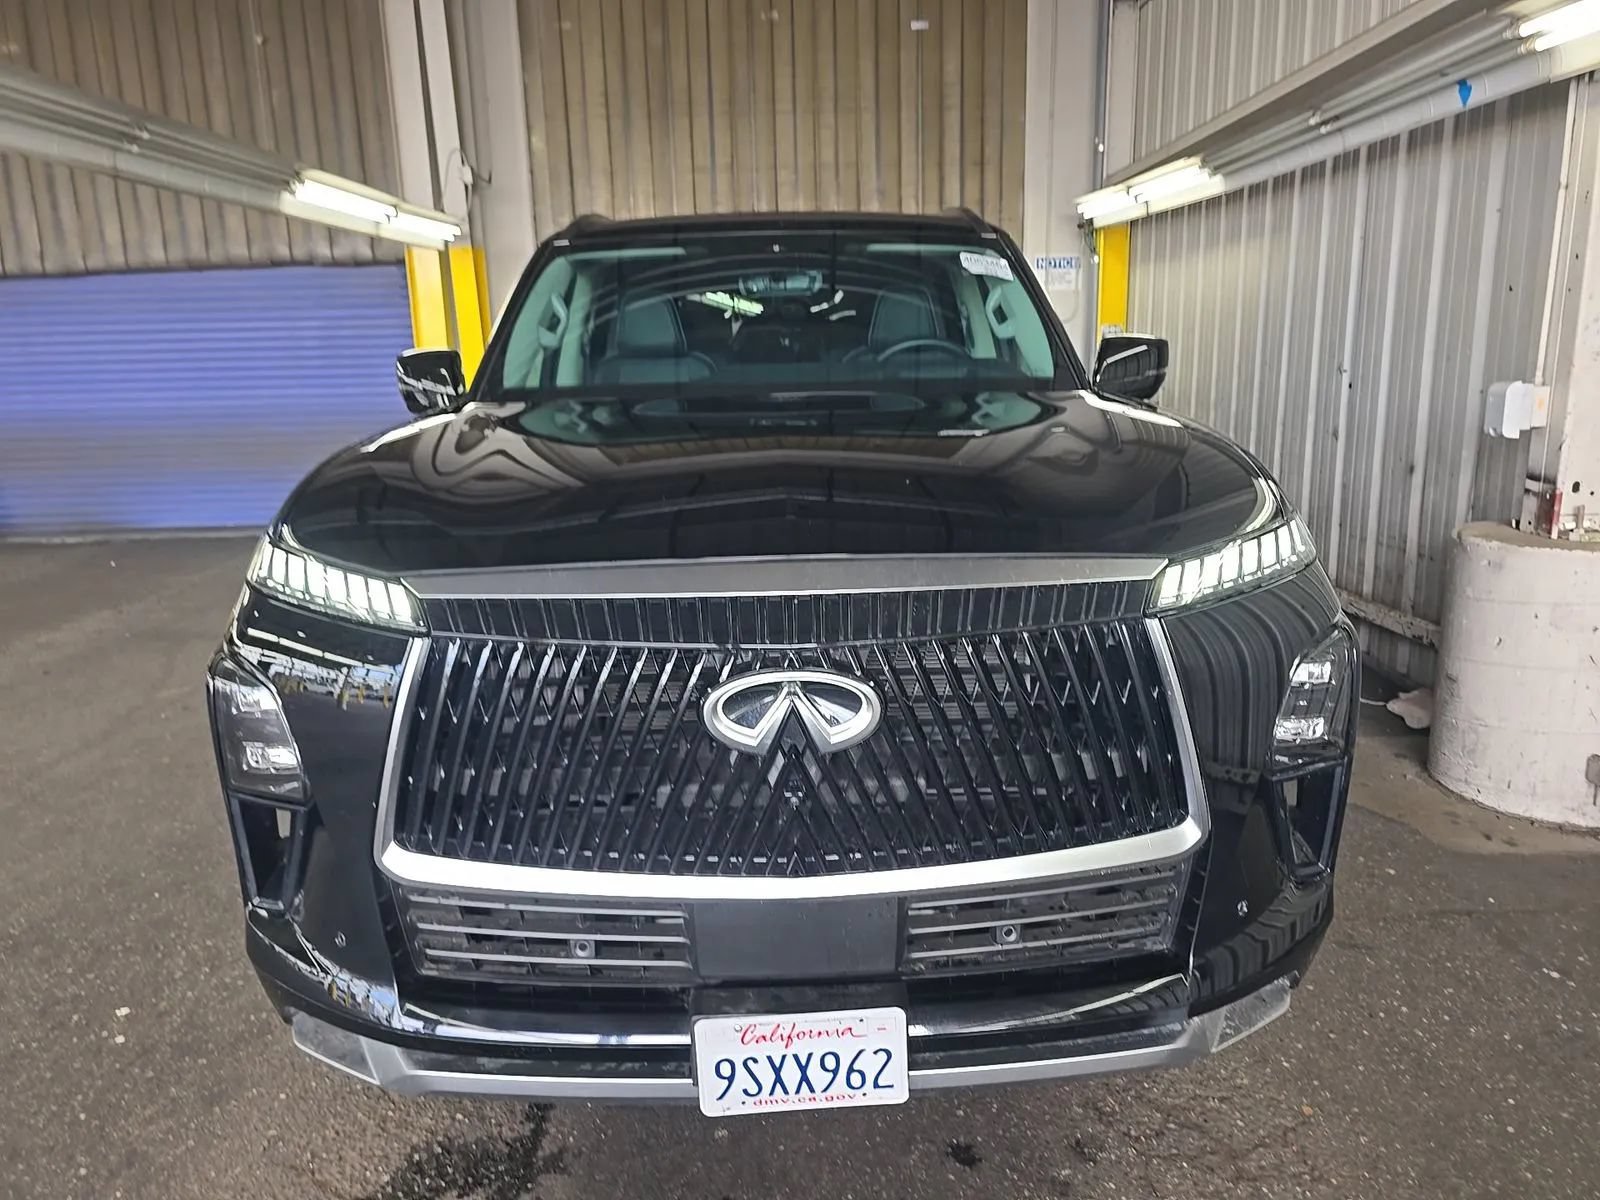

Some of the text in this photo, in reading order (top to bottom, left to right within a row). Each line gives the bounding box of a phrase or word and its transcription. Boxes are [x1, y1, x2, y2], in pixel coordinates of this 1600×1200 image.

[741, 1022, 867, 1048] California
[714, 1048, 894, 1101] 9SXX962
[752, 1093, 857, 1107] dmv.ca.gov
